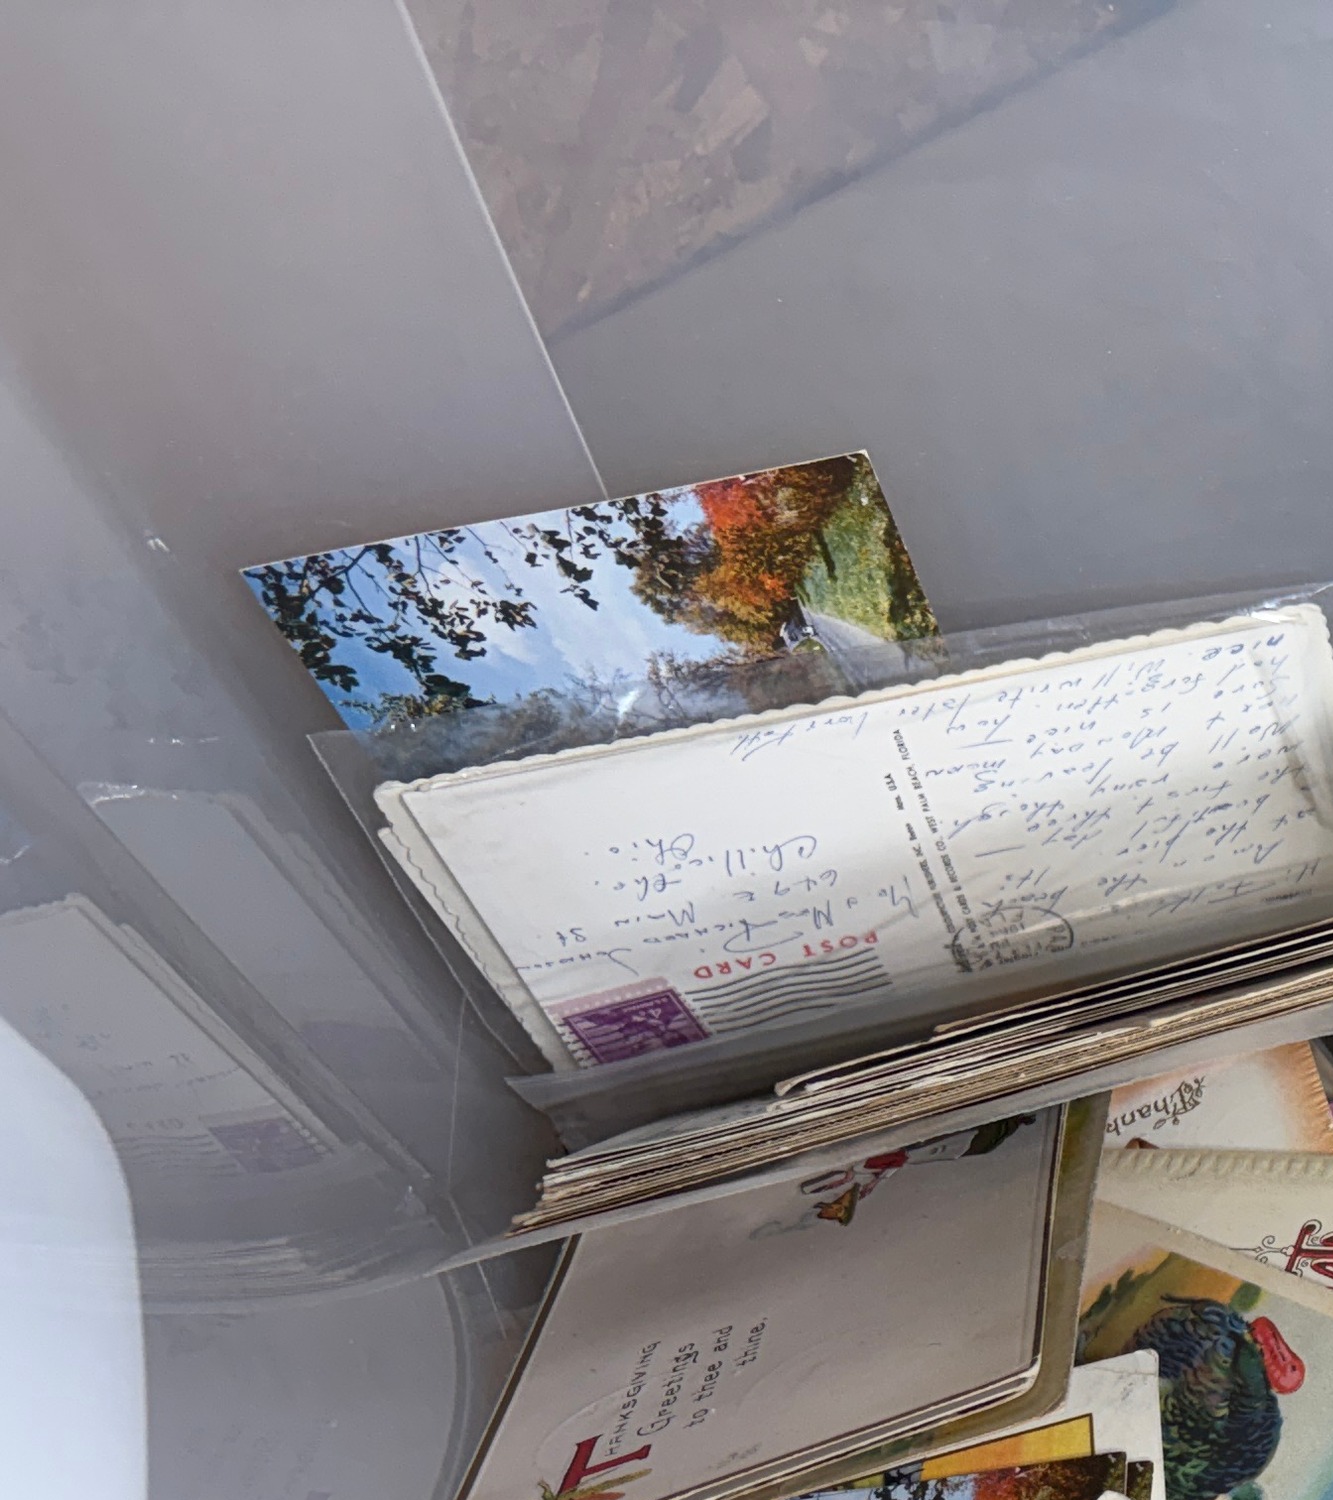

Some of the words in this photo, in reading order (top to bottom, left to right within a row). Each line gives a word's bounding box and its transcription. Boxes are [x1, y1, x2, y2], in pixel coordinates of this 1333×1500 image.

[892, 728, 910, 761] FLORIDA
[917, 793, 931, 813] PALM
[924, 815, 939, 834] WEST
[802, 929, 879, 958] POST
[693, 952, 777, 980] CARD
[690, 1358, 723, 1406] thee
[713, 1324, 734, 1354] and
[638, 1342, 698, 1436] Greetings
